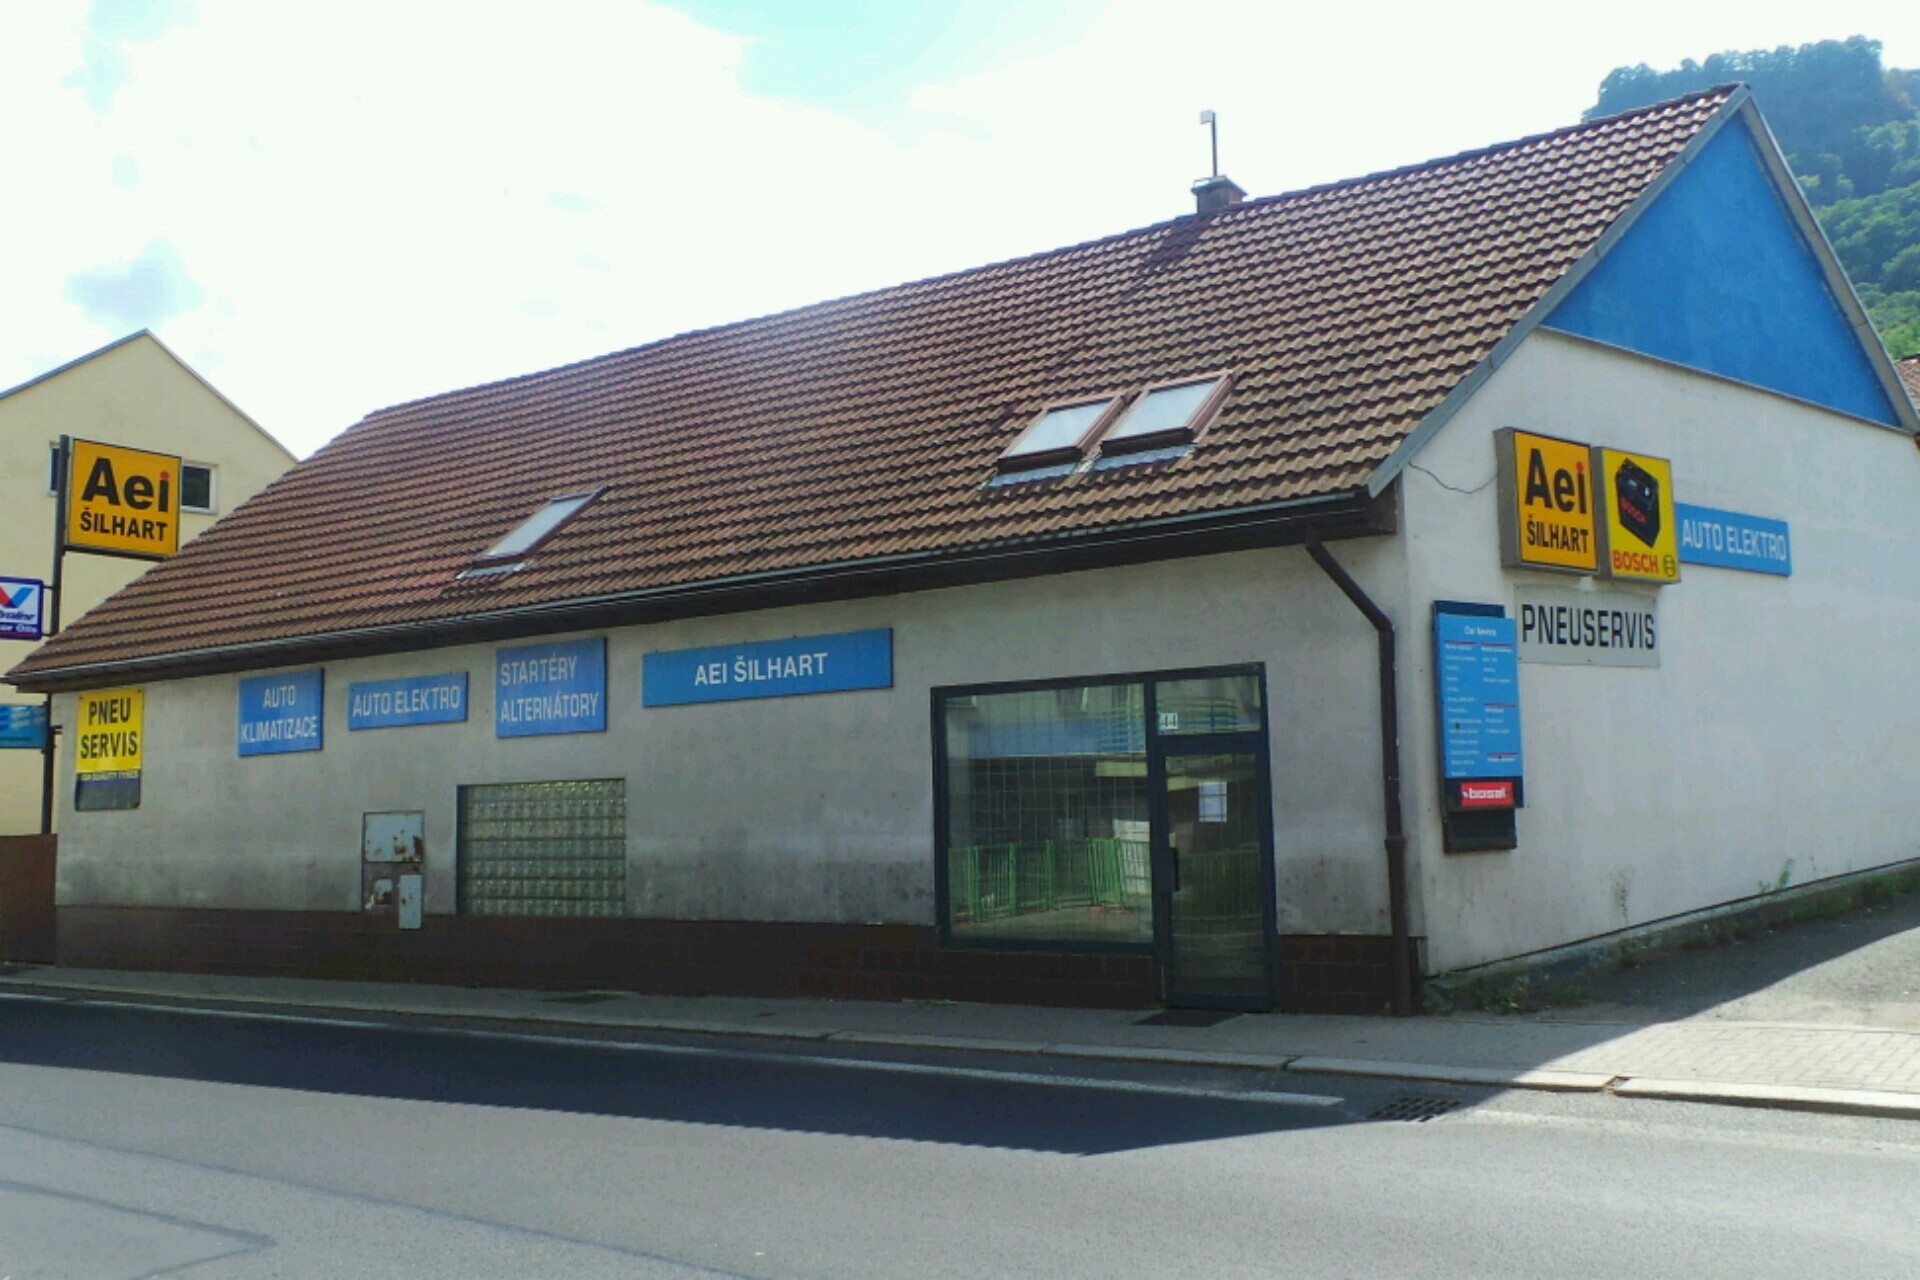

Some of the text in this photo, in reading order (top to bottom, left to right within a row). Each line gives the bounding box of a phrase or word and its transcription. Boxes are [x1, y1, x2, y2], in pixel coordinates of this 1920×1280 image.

[81, 457, 170, 513] Aei
[1525, 448, 1587, 514] Aei
[80, 507, 168, 542] ŠILHART
[1526, 514, 1589, 554] ŠILHART
[1682, 518, 1788, 561] AUTO ELEKTRO
[1613, 549, 1659, 574] BOSCH
[1522, 604, 1656, 650] PNEUSERVIS
[501, 655, 577, 684] STARTÉRY
[694, 652, 828, 686] AEI ŠILHART
[88, 698, 131, 725] PNEU
[263, 685, 296, 709] AUTO
[353, 685, 461, 718] AUTO ELEKTRO
[500, 691, 600, 724] ALTERNÁTORY
[80, 731, 138, 759] SERVIS
[240, 716, 318, 743] KLIMATIZACE
